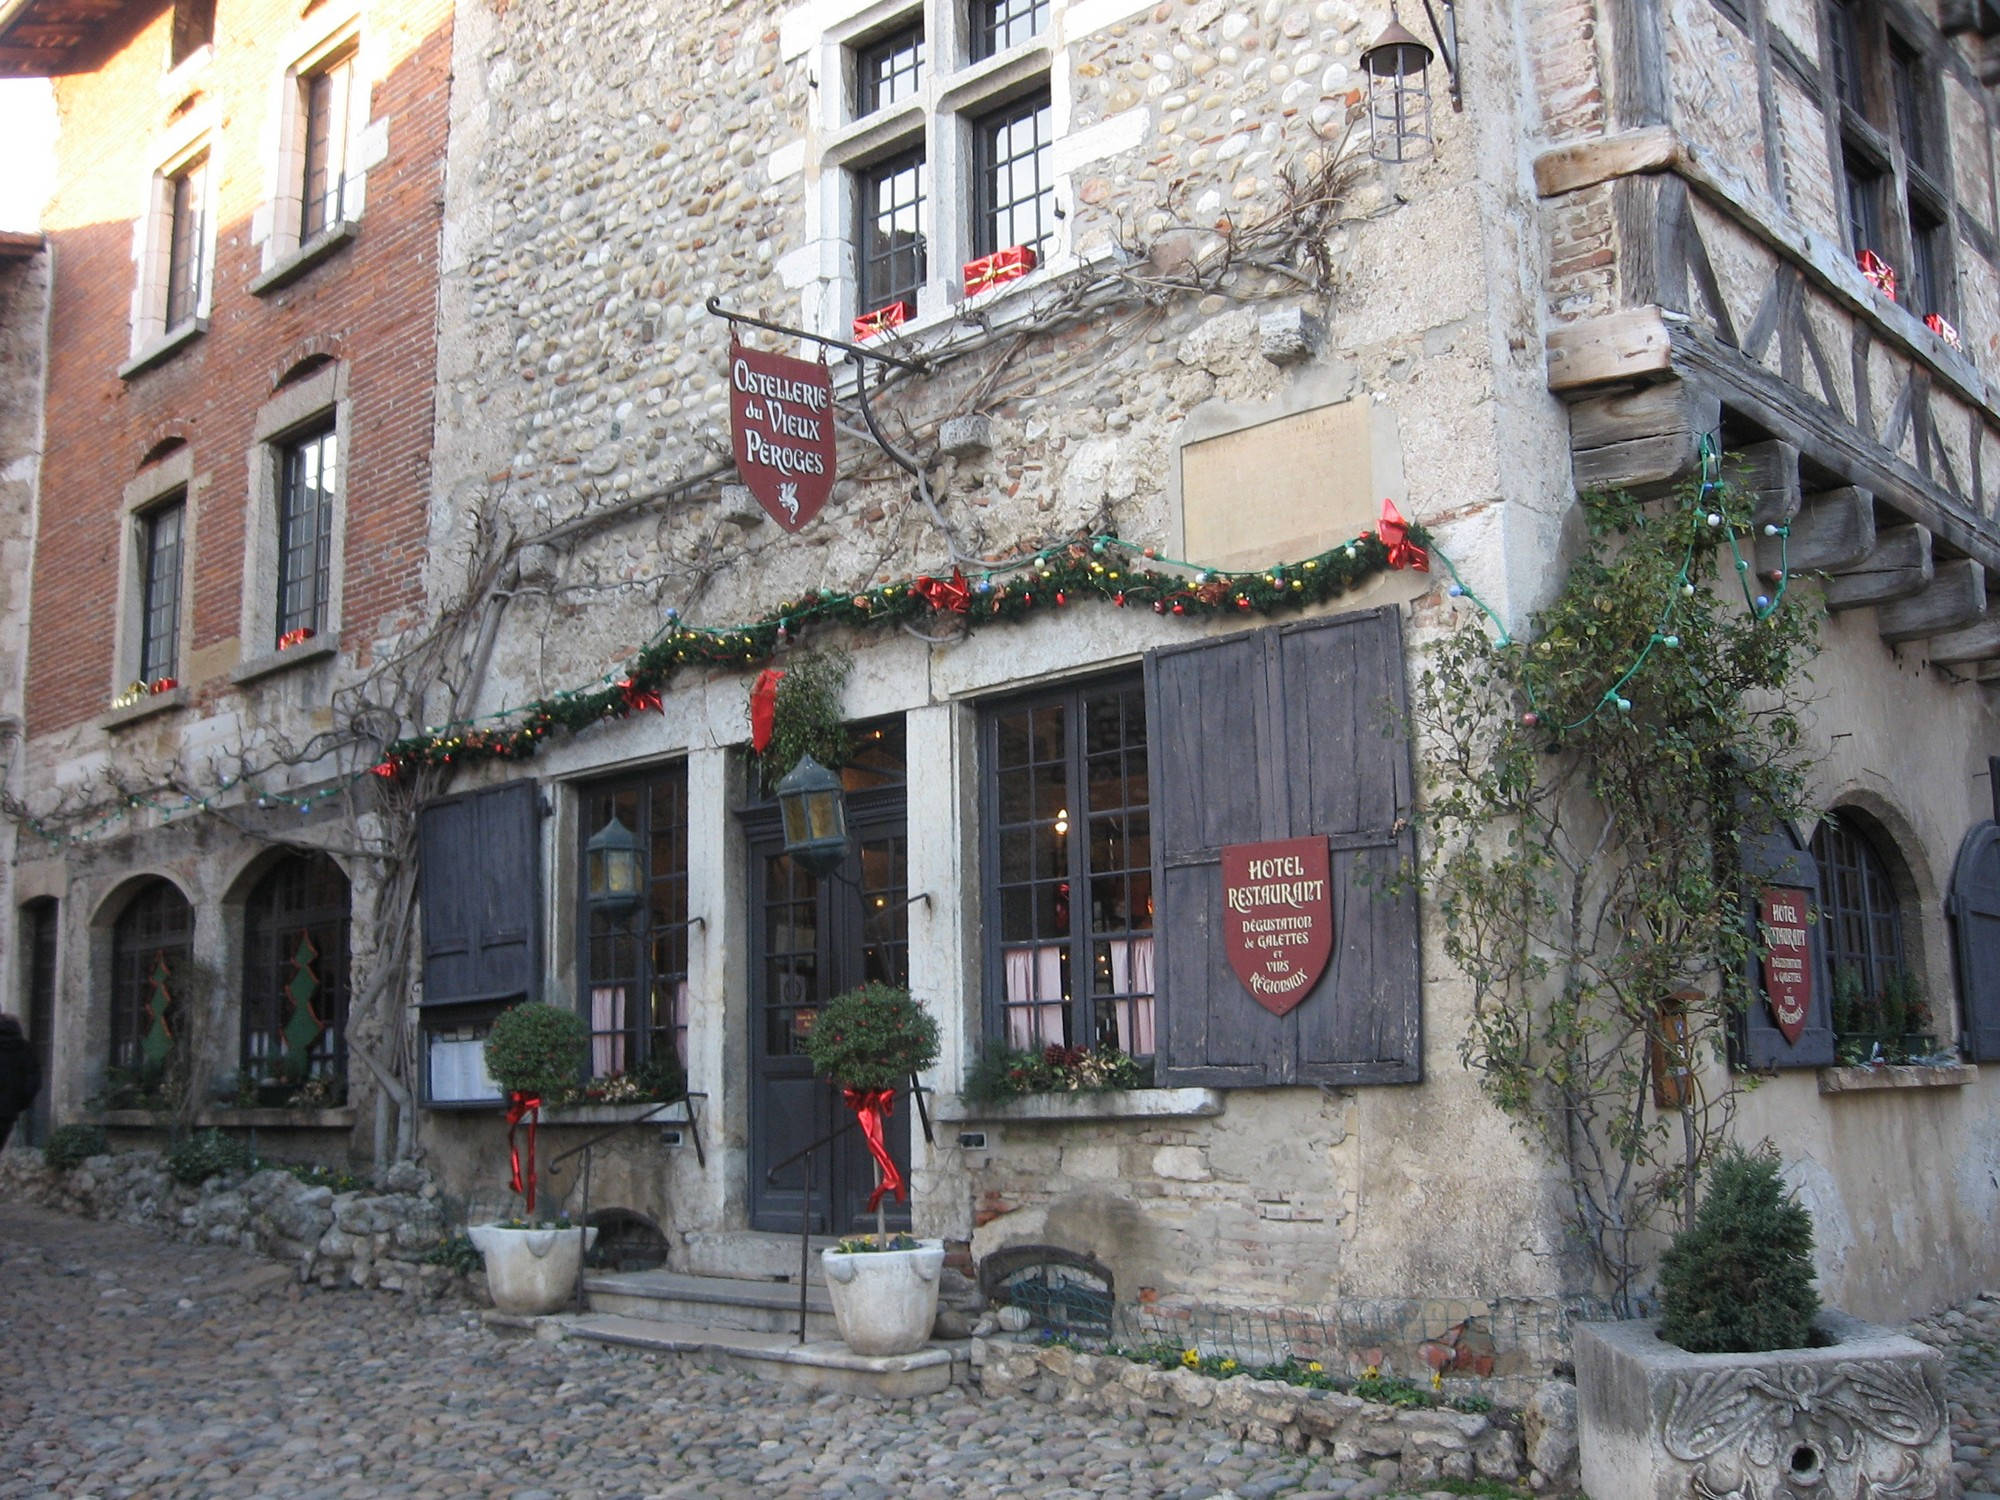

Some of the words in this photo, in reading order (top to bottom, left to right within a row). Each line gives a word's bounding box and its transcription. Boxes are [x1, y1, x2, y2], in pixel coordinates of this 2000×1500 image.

[733, 358, 828, 414] OSTELLERIE
[745, 399, 763, 421] du
[765, 399, 821, 442] VIEUX
[744, 428, 824, 477] PÉROGES
[1248, 855, 1304, 880] HOTEL
[1228, 879, 1324, 914] RESTAURANT
[1772, 903, 1798, 924] HOTEL
[1257, 931, 1309, 950] GALETTES
[1761, 926, 1806, 953] RTAURANT
[1266, 960, 1290, 973] VINS
[1273, 950, 1283, 959] ET
